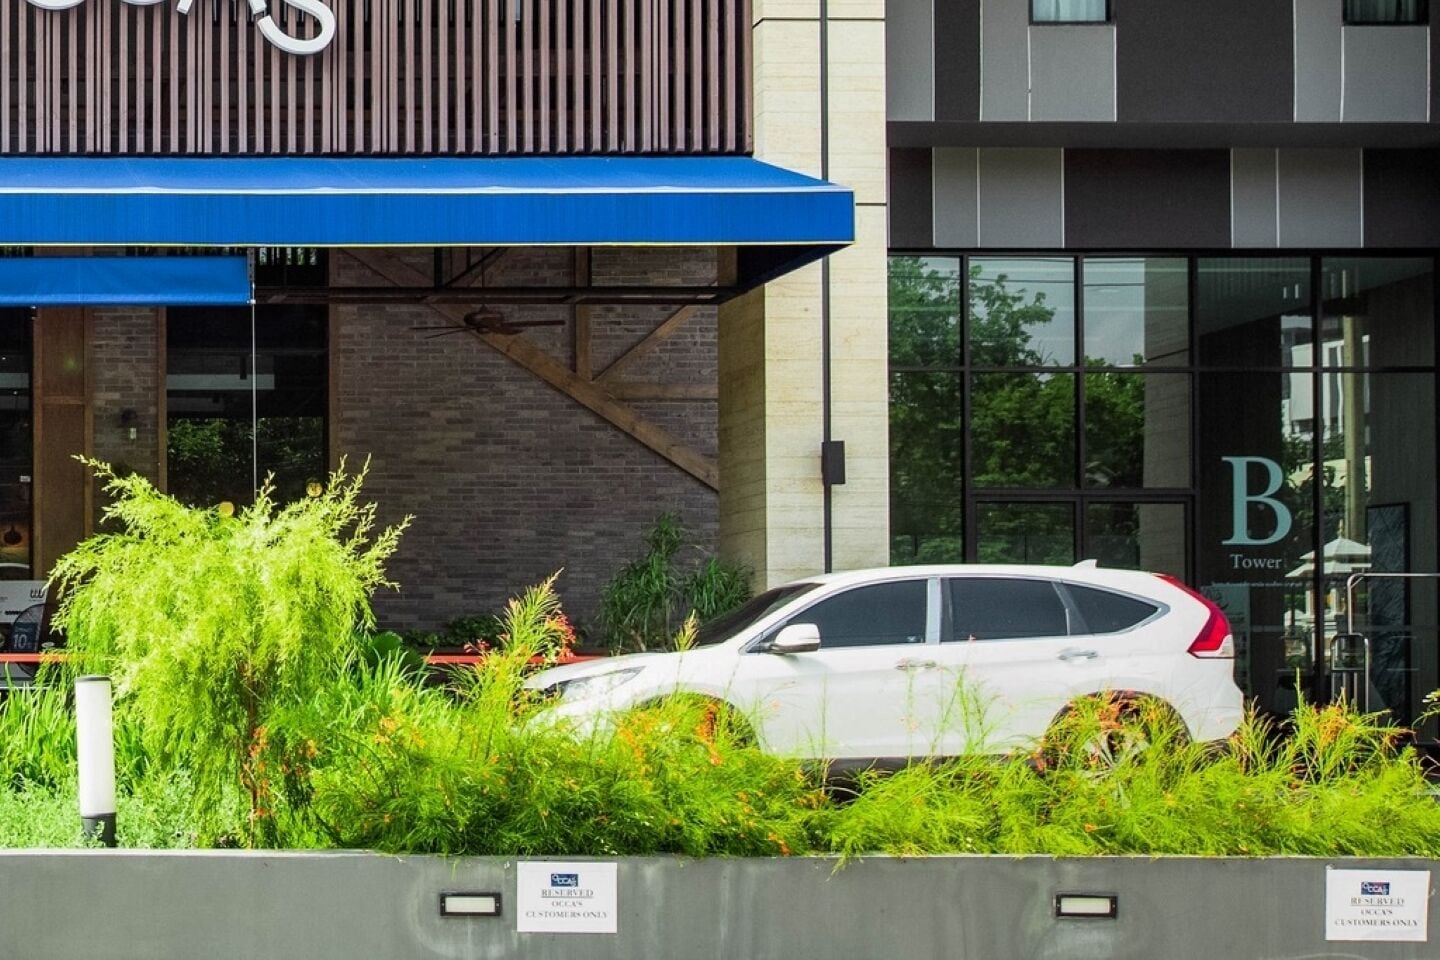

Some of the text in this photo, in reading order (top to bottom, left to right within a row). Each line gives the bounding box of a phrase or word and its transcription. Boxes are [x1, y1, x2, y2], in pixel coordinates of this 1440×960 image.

[1221, 456, 1292, 545] B
[1229, 553, 1282, 569] Tower
[541, 888, 594, 898] RESERVED
[1351, 897, 1405, 906] RESERVED
